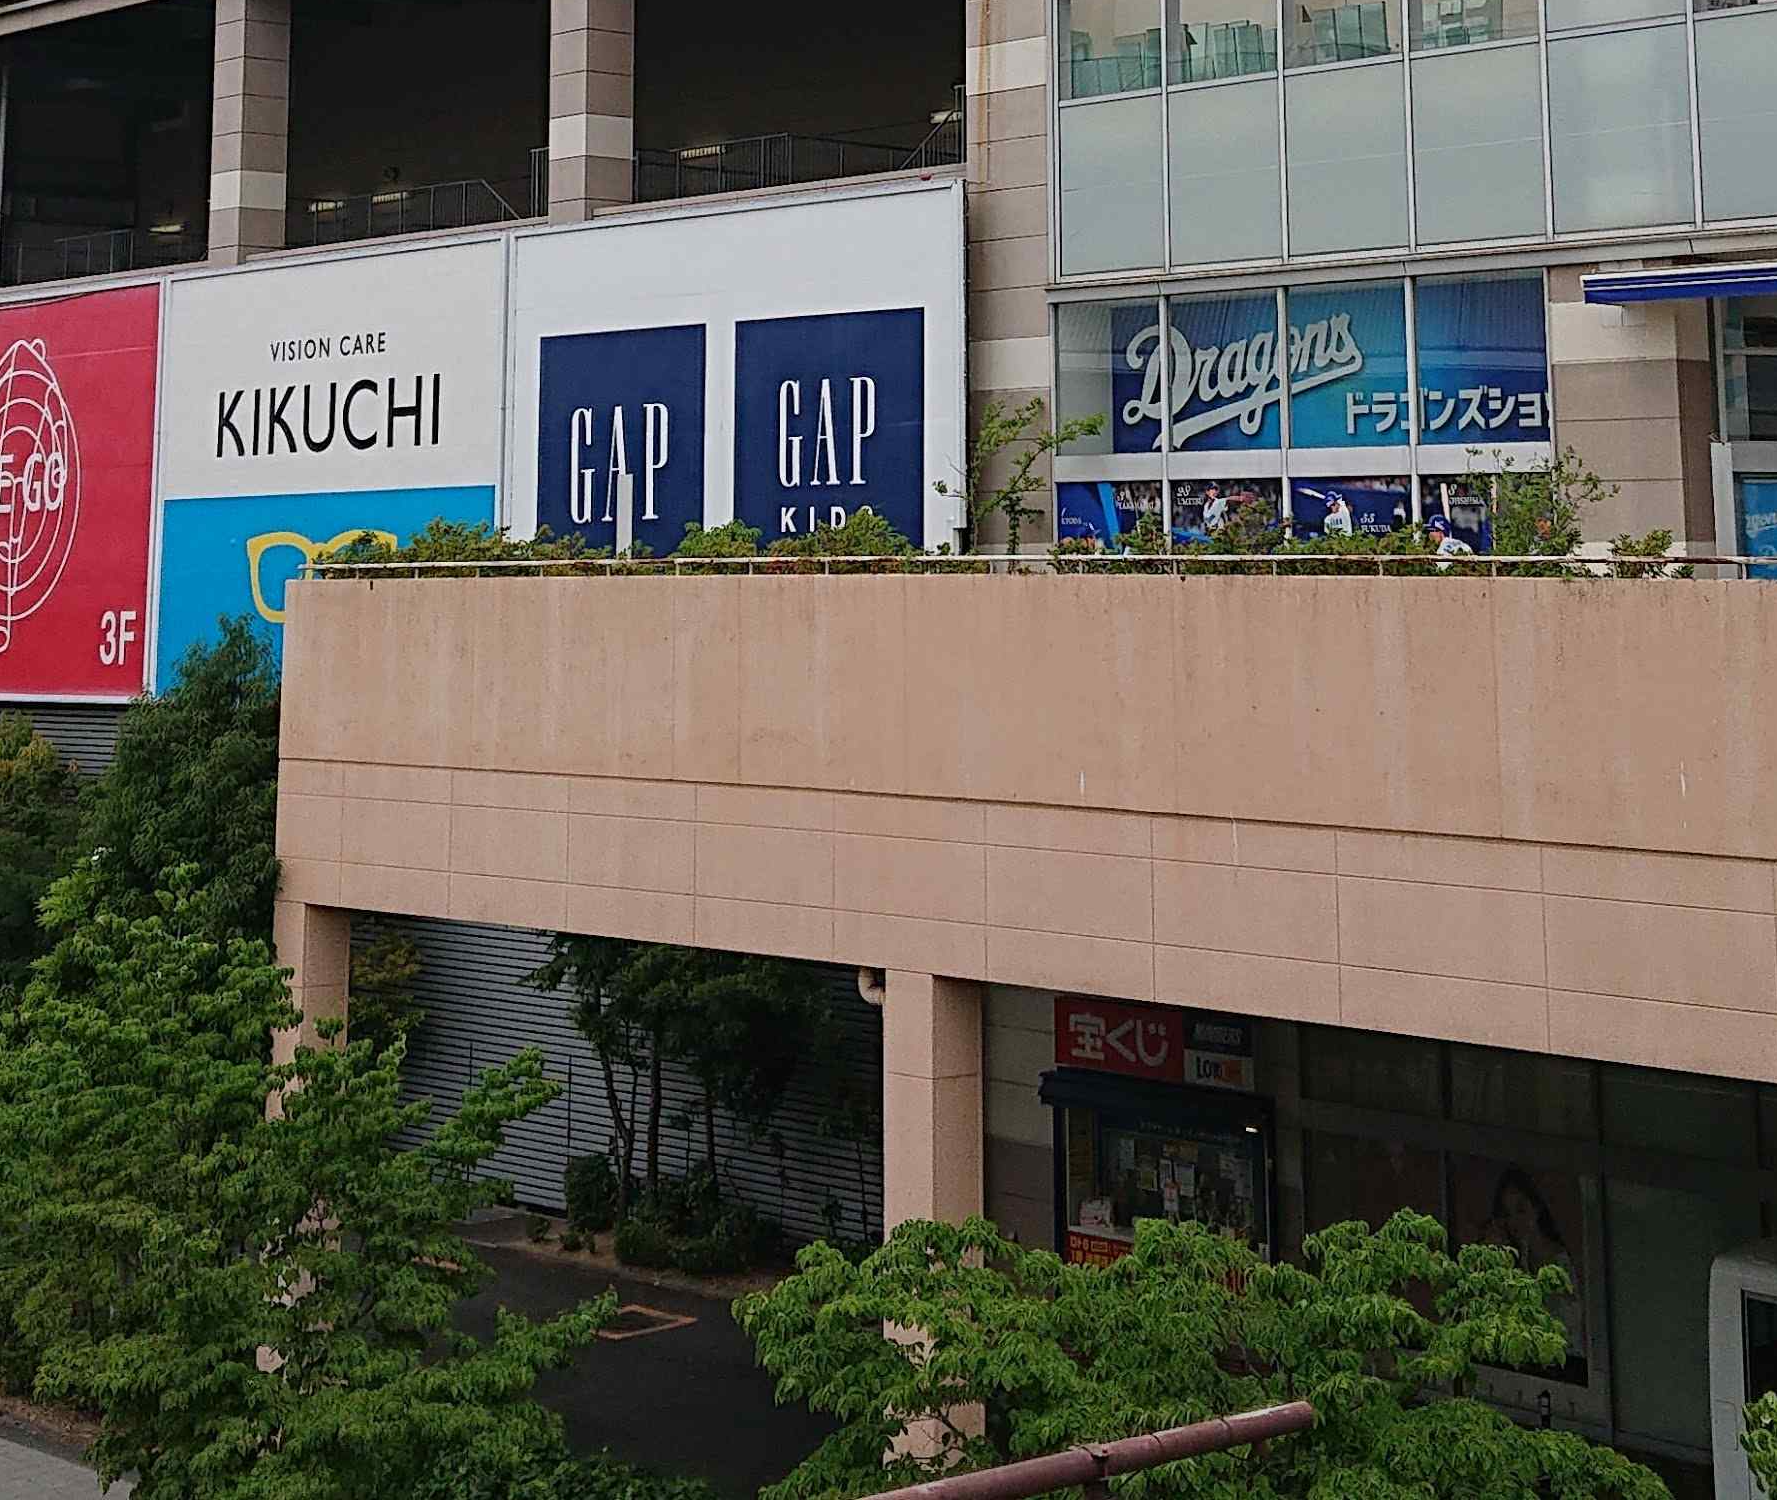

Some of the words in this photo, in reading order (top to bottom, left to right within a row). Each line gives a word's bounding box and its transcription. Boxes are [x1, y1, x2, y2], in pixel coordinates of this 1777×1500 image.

[270, 337, 331, 362] VISION
[339, 332, 387, 356] CARE
[1123, 312, 1362, 450] Dragons
[216, 373, 441, 458] KIKUCHI
[778, 376, 877, 488] GAP
[570, 403, 669, 525] GAP
[780, 505, 873, 534] KID
[99, 610, 137, 666] 3F
[1069, 1012, 1169, 1067] 宝くじ
